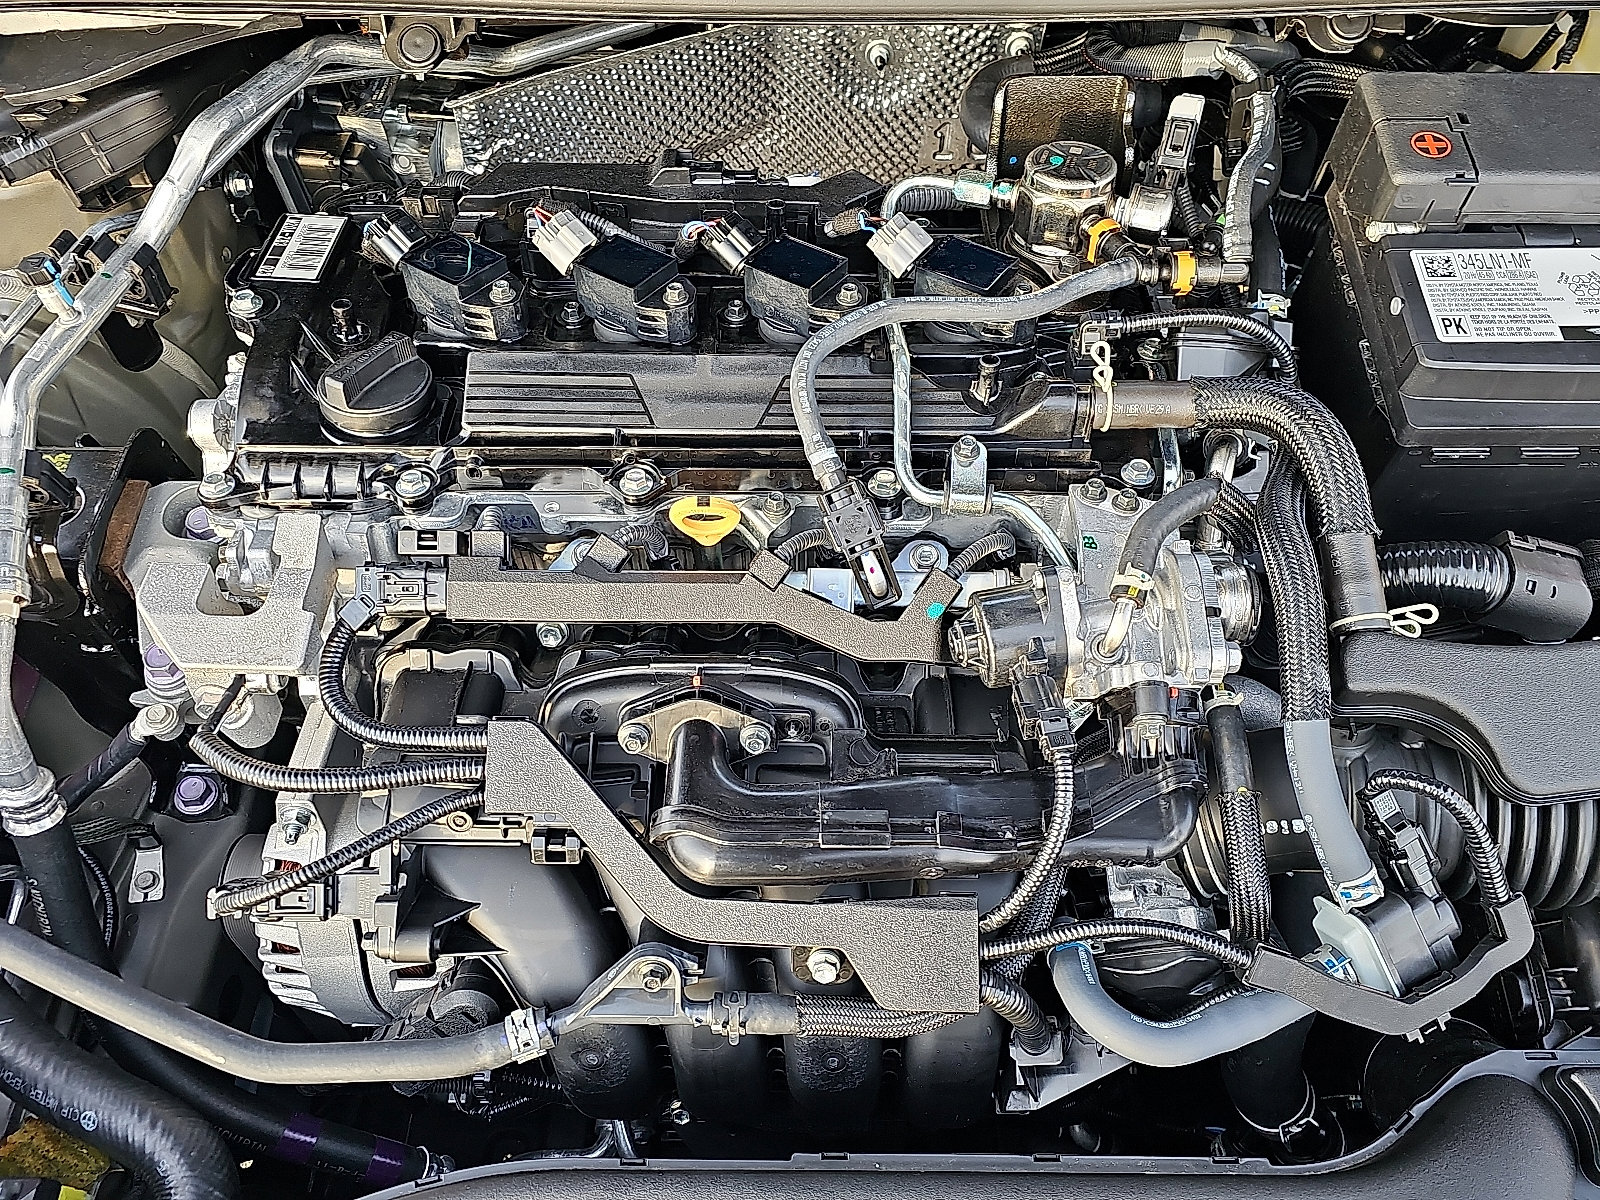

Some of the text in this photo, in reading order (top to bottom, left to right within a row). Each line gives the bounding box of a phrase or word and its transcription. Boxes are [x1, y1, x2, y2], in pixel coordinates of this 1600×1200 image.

[1457, 252, 1532, 269] 345LN1-MF
[1441, 317, 1468, 335] PK
[61, 1106, 80, 1122] CIP
[213, 1125, 268, 1151] ICHIRIN
